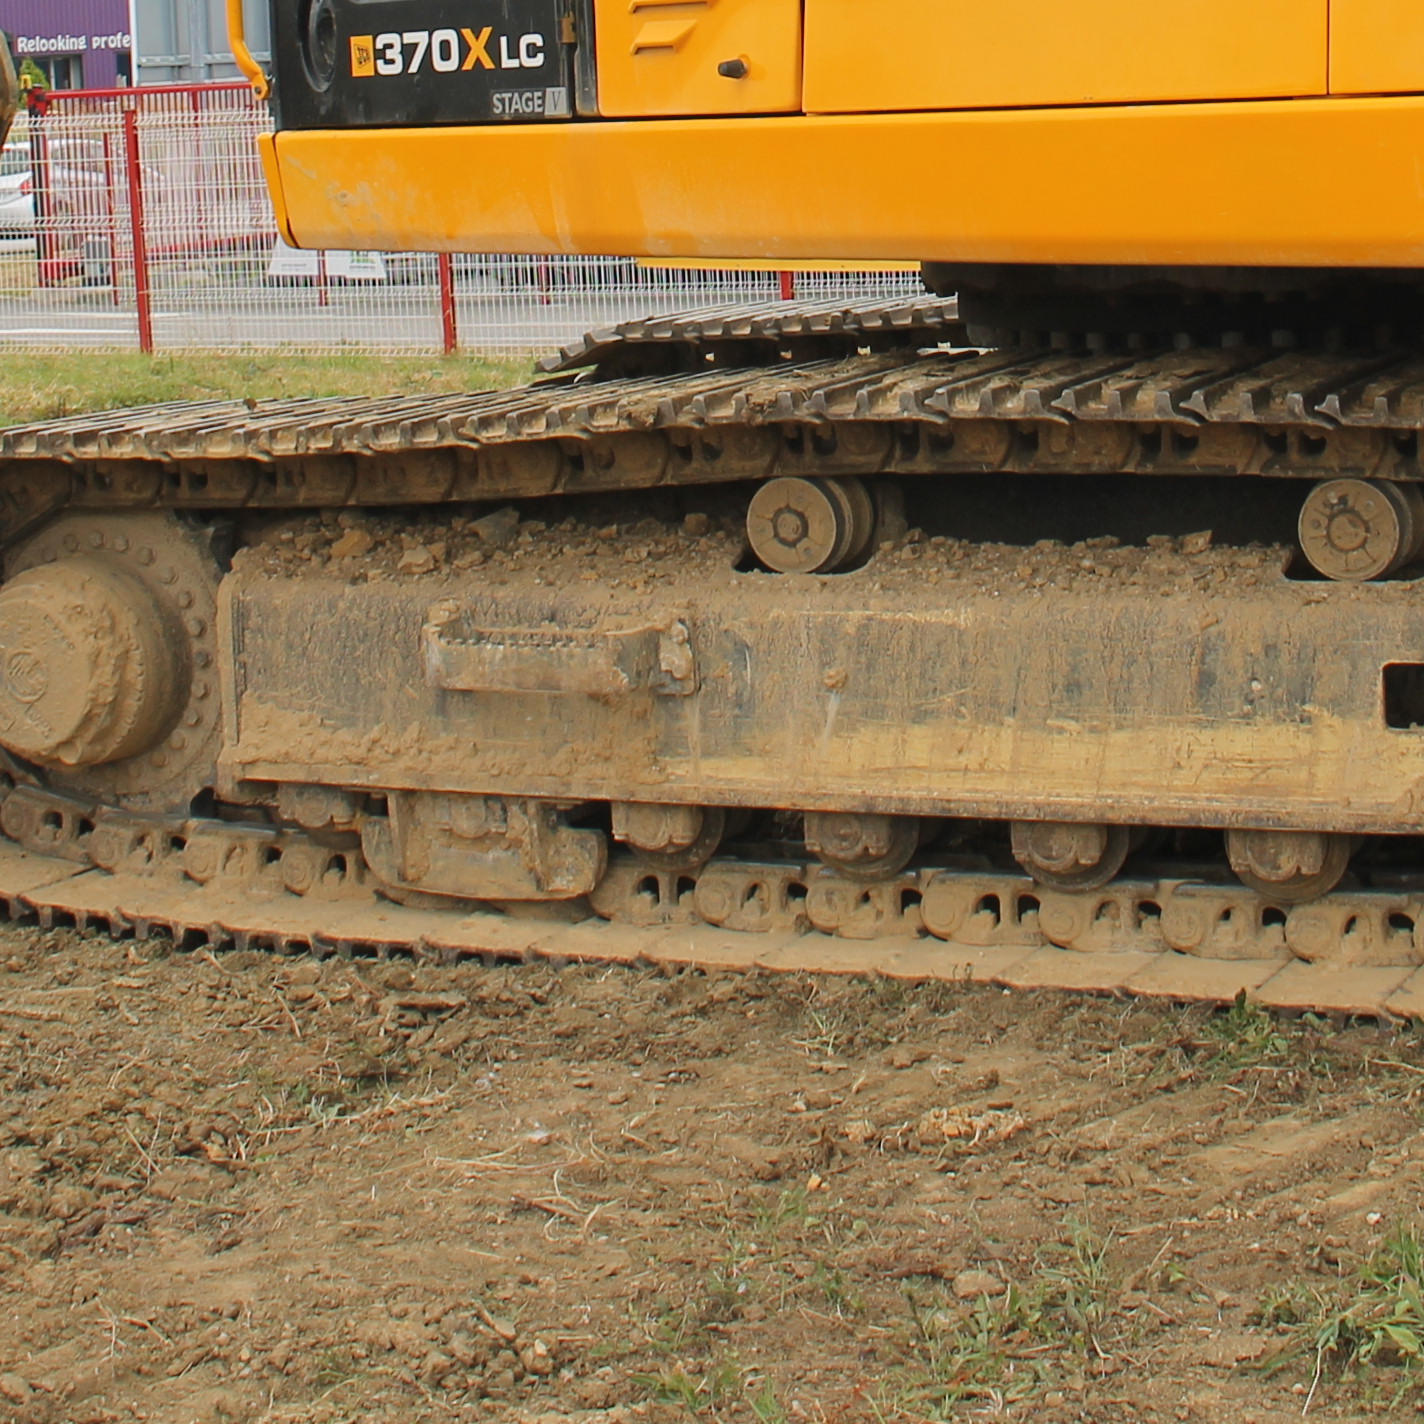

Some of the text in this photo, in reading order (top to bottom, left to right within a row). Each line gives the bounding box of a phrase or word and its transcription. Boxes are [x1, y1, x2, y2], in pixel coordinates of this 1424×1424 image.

[17, 34, 87, 52] Relooking
[375, 26, 496, 76] 370X
[499, 33, 545, 69] LC
[492, 90, 545, 115] STAGE
